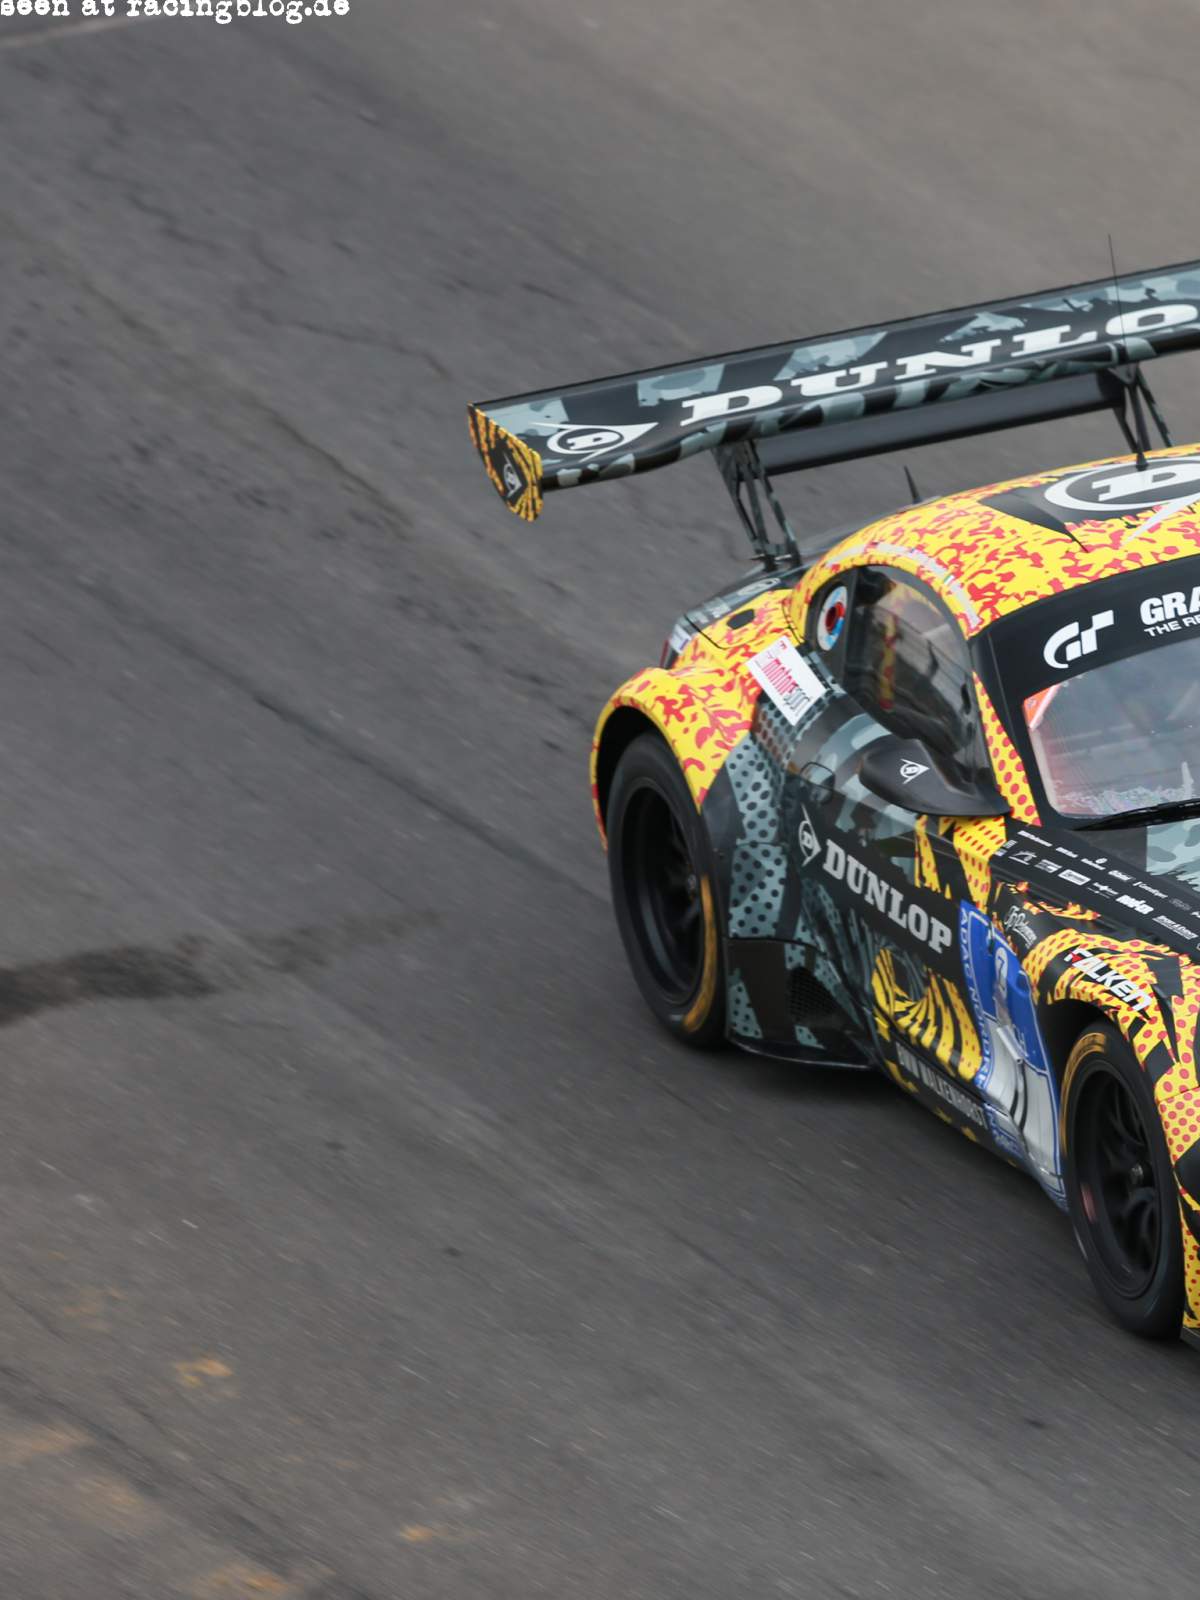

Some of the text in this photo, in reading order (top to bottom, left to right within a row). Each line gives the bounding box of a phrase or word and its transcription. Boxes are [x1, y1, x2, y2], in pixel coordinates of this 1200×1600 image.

[1144, 620, 1183, 637] THE
[822, 839, 952, 954] DUNLOP
[1063, 947, 1154, 1012] FALKEN
